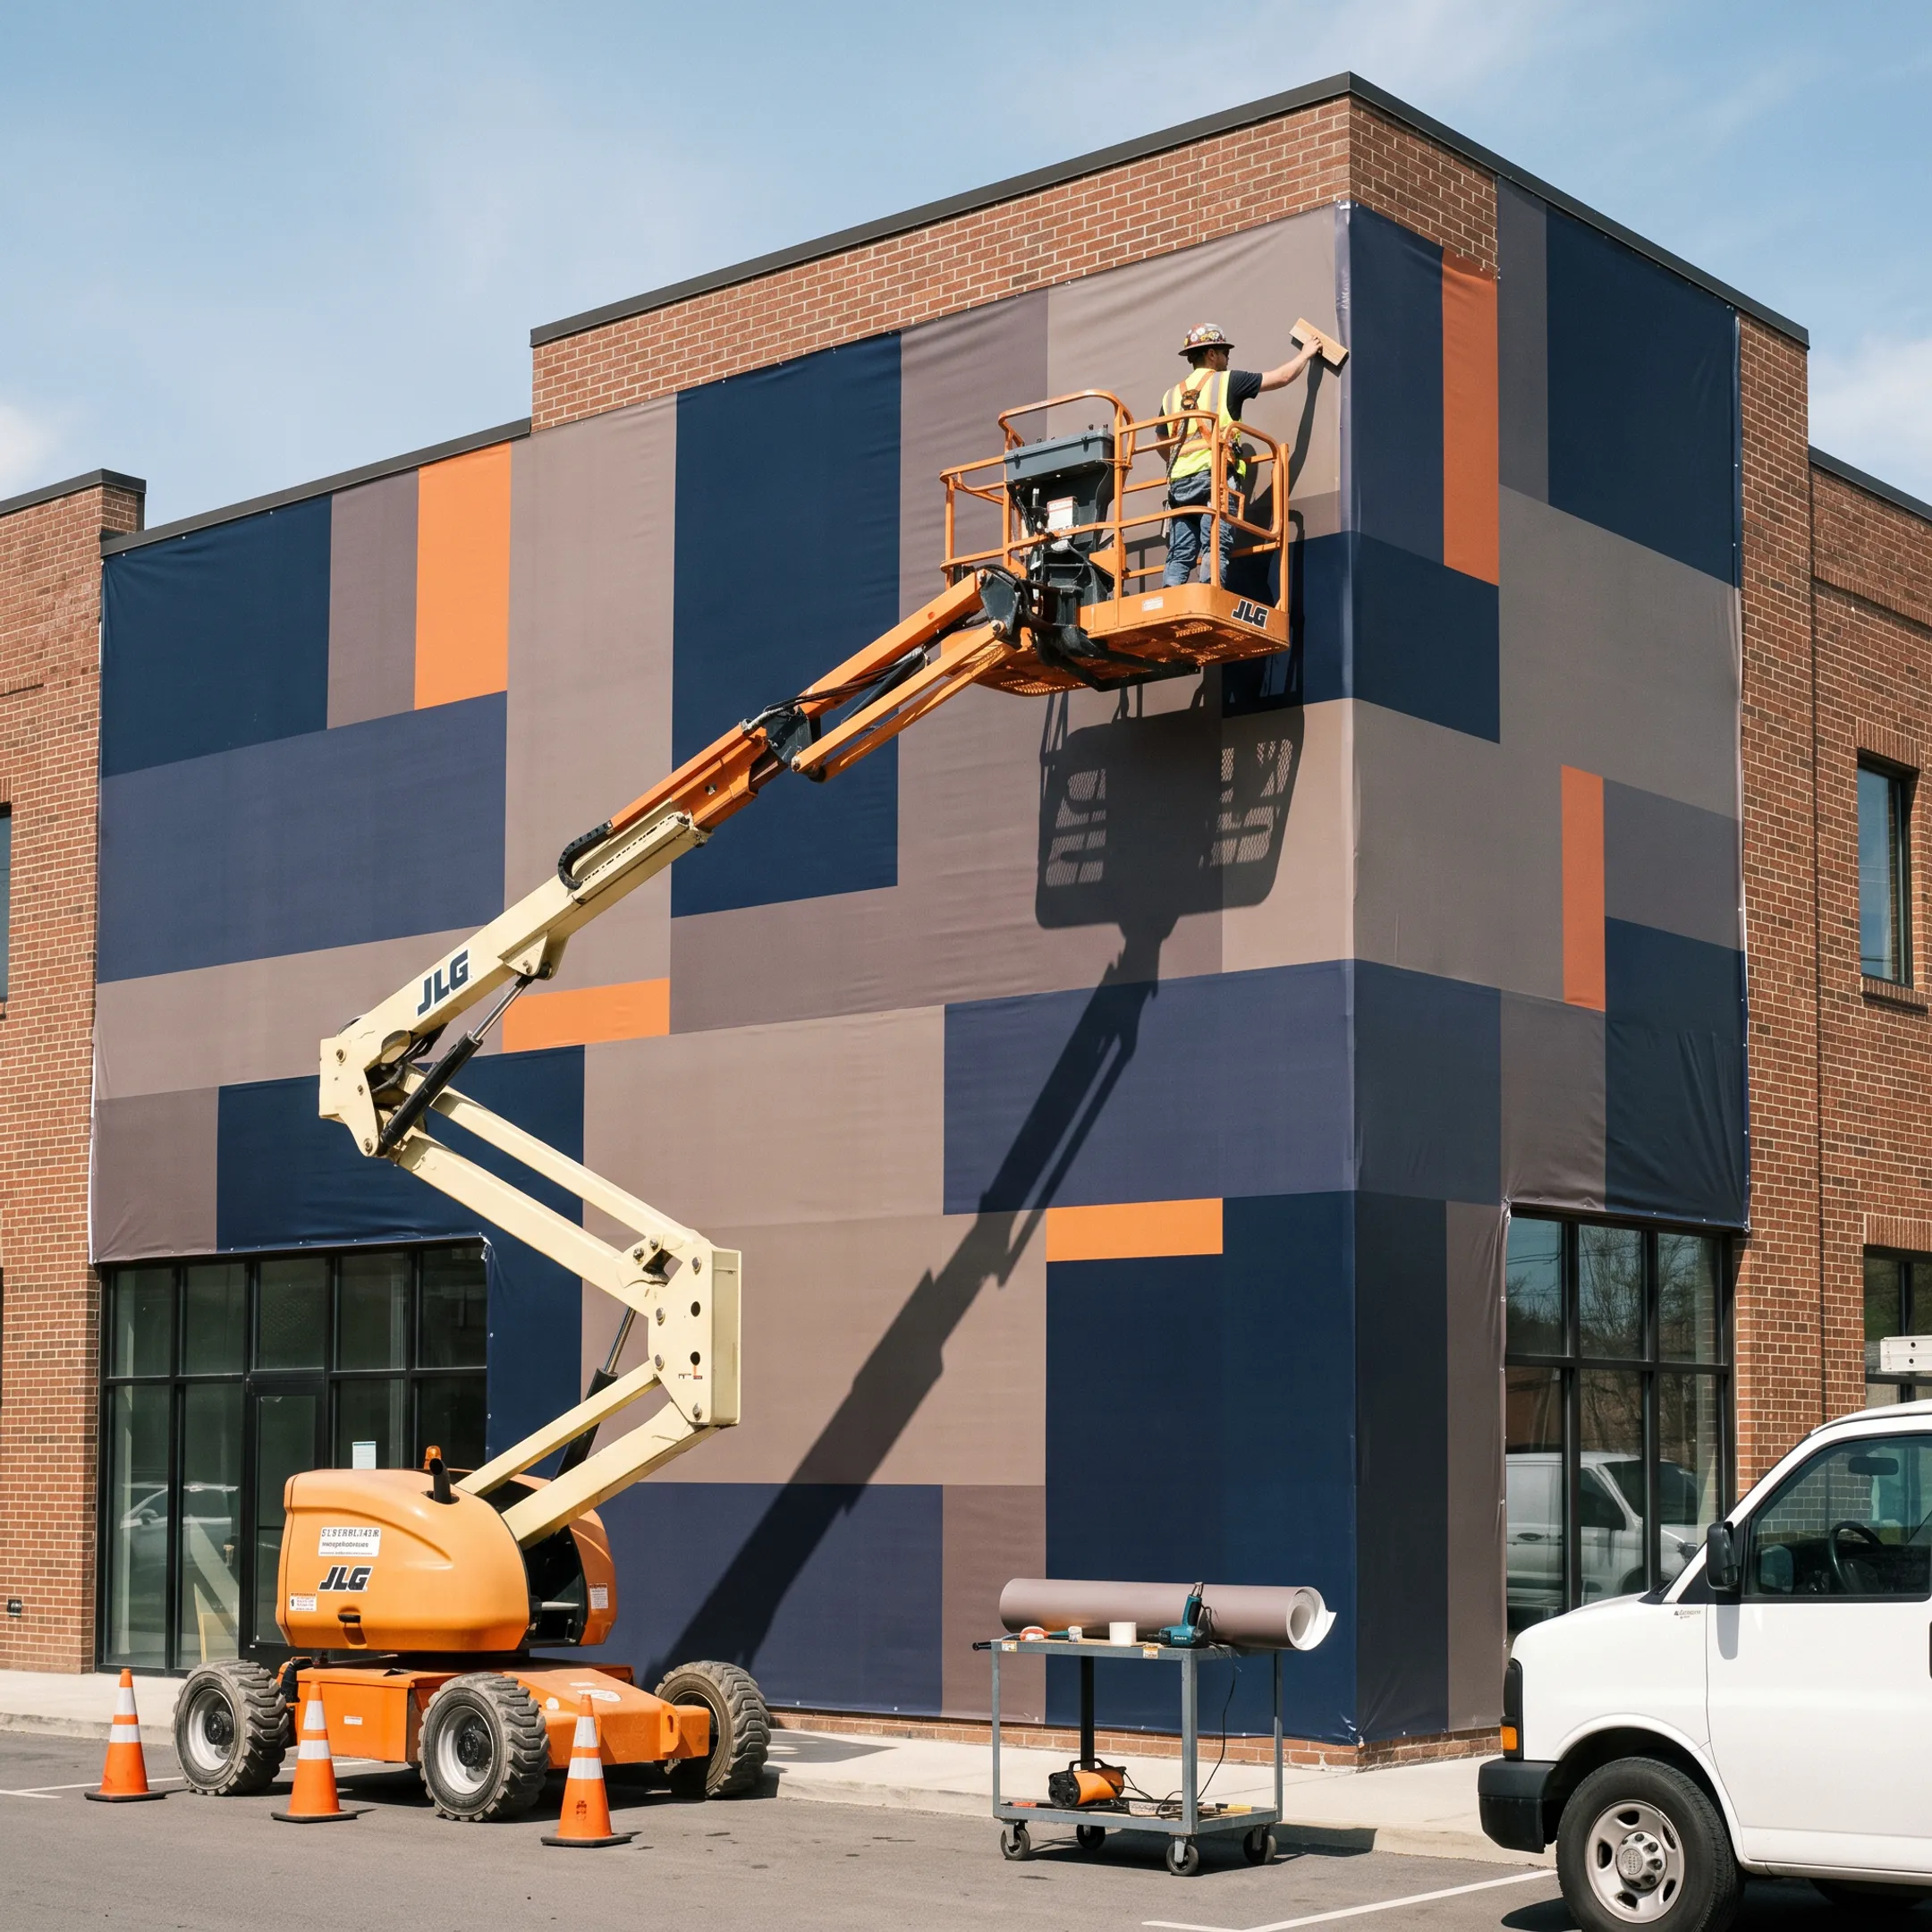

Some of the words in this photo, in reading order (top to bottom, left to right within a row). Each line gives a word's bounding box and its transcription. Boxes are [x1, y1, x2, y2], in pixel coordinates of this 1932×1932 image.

[1232, 599, 1269, 628] JLG
[417, 949, 469, 1016] JLG
[318, 1566, 372, 1591] JLG
